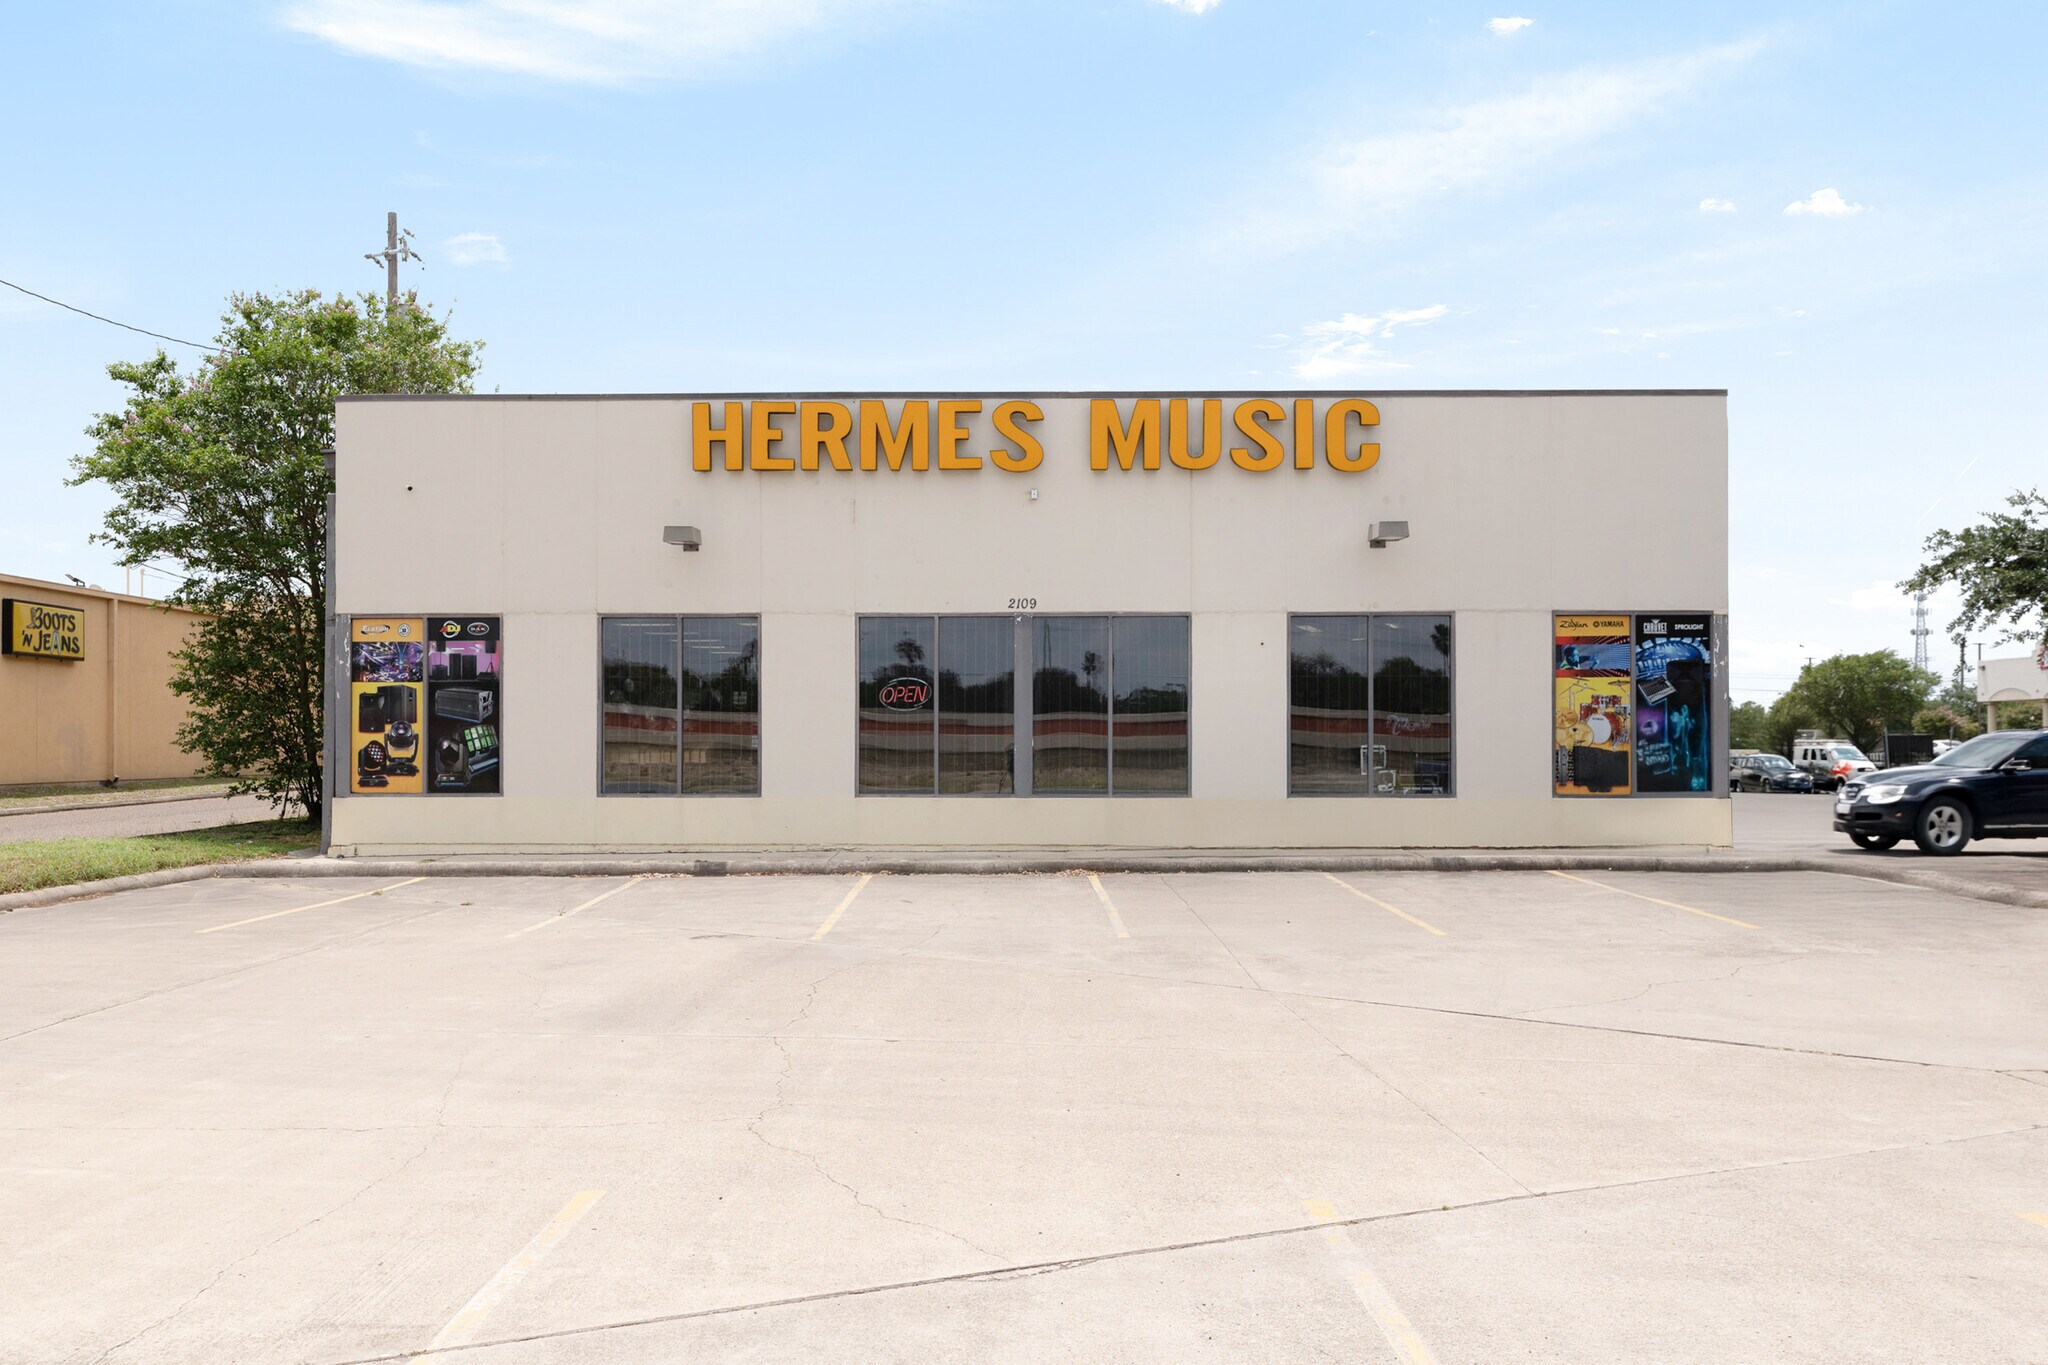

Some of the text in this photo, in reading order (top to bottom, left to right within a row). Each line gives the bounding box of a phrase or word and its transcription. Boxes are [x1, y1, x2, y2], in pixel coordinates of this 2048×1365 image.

[692, 399, 1380, 472] HERMES MUSIC
[1008, 598, 1037, 609] 2109
[34, 607, 76, 632] BOOTS
[33, 631, 80, 654] JEANS
[882, 685, 928, 703] OPEN
